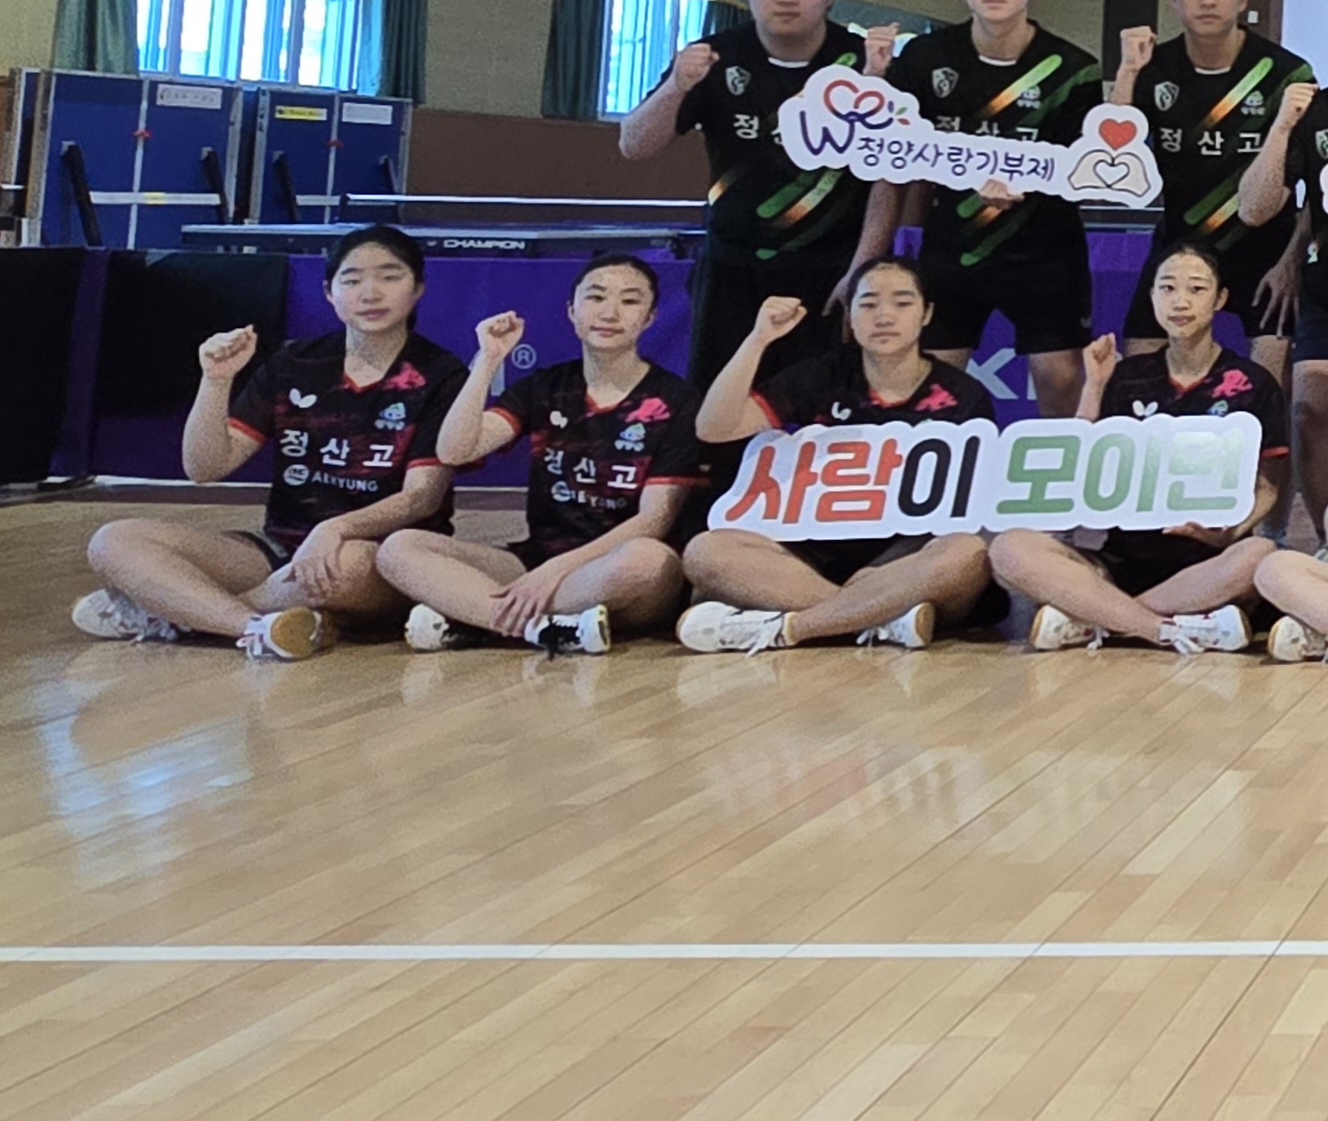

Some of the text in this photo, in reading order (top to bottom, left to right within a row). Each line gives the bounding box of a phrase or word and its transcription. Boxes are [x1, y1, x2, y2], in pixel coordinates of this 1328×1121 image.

[856, 136, 1056, 182] 청양사랑기부제
[280, 429, 395, 468] 정산고
[724, 434, 981, 524] 사람이
